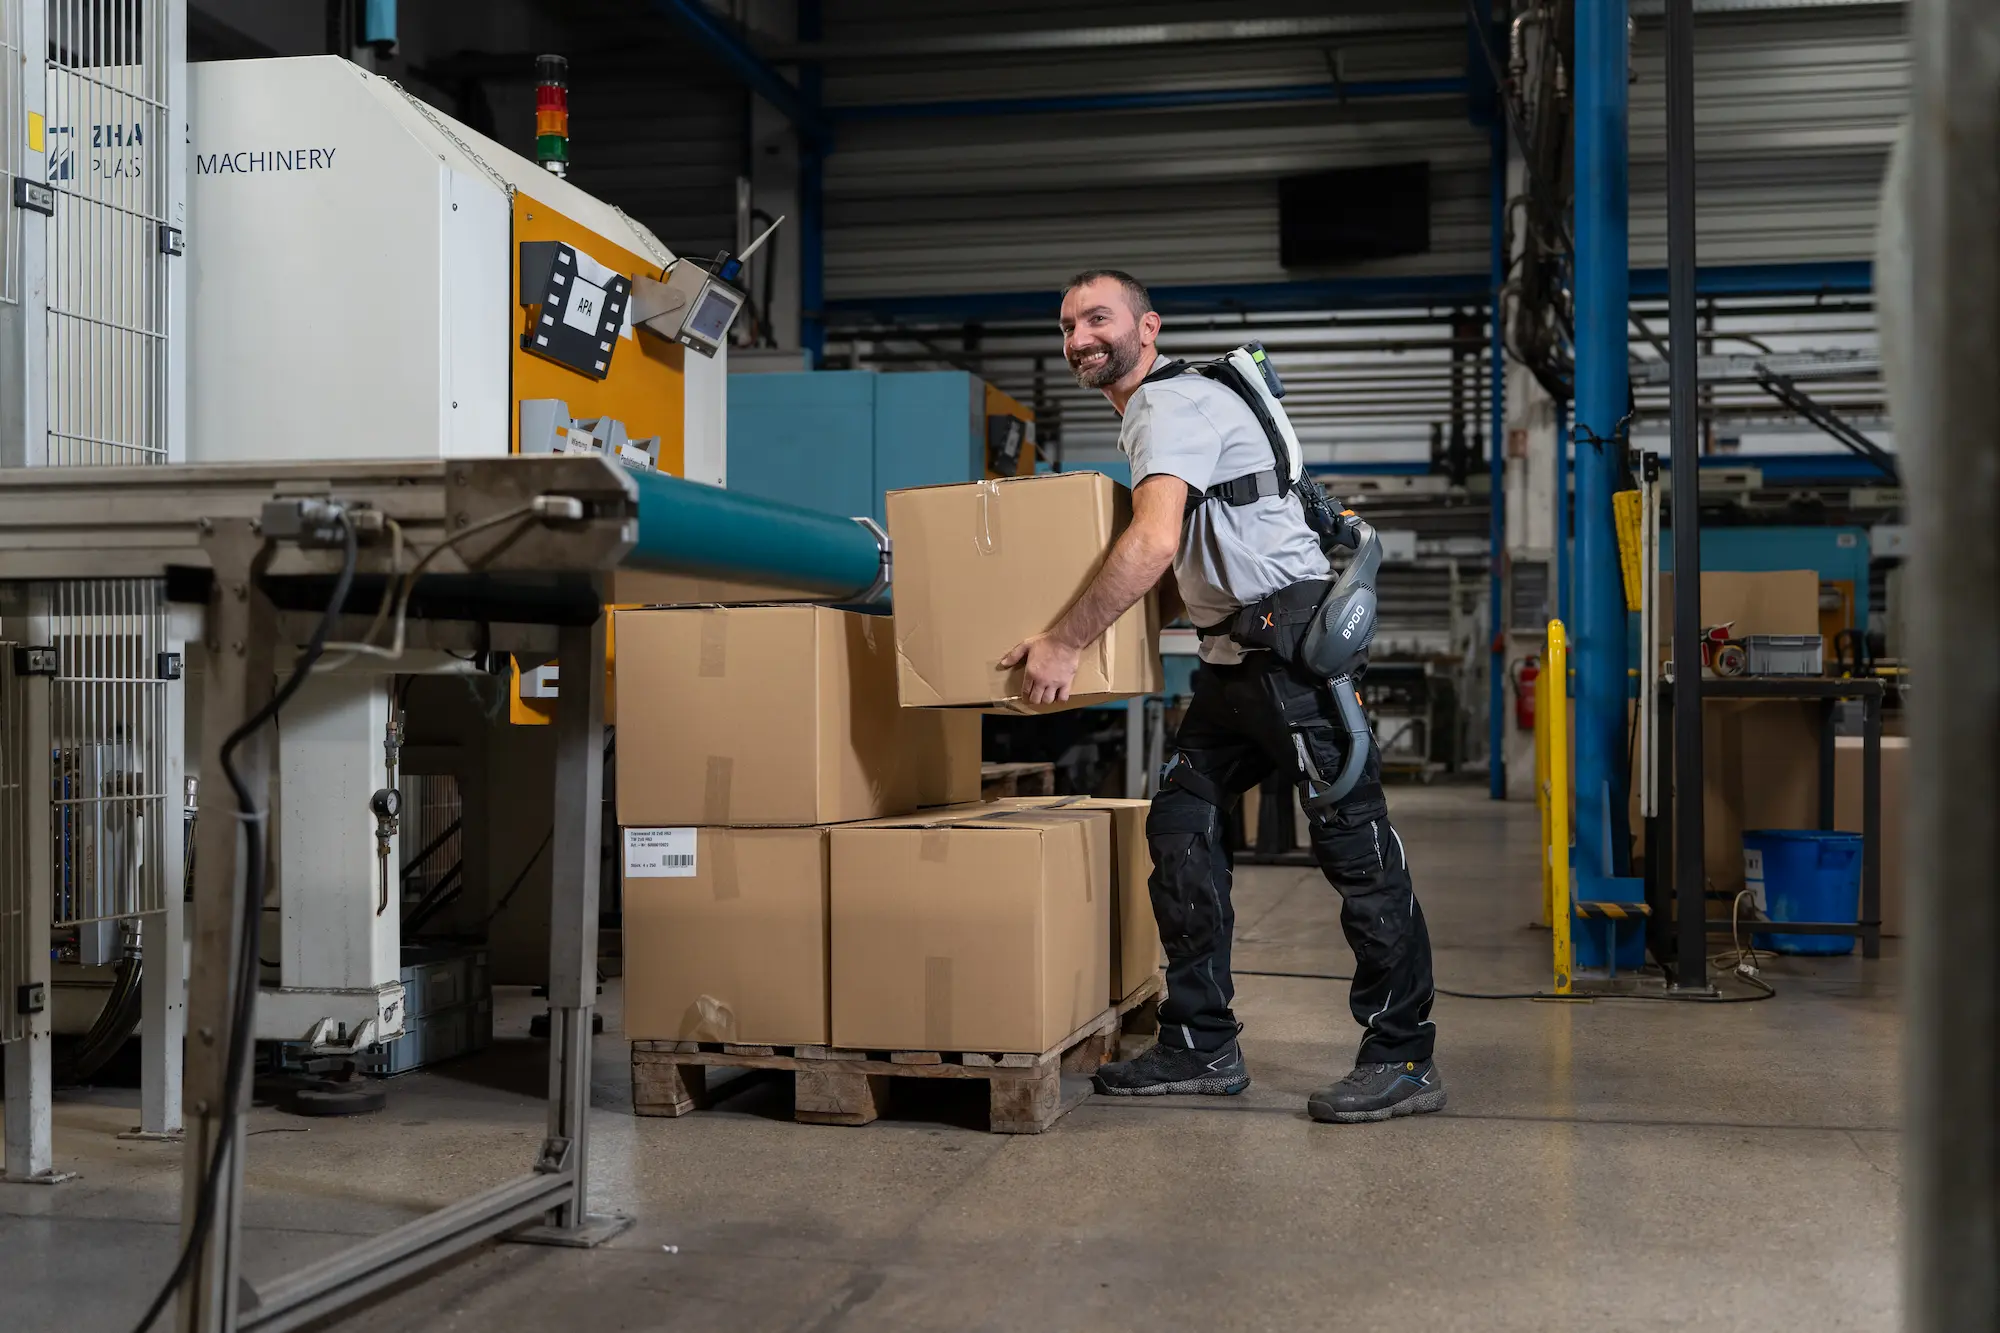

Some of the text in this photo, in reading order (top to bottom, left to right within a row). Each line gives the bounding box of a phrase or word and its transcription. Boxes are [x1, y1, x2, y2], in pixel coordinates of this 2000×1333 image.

[196, 147, 336, 175] MACHINERY
[577, 297, 593, 317] APA
[1342, 604, 1365, 640] B900
